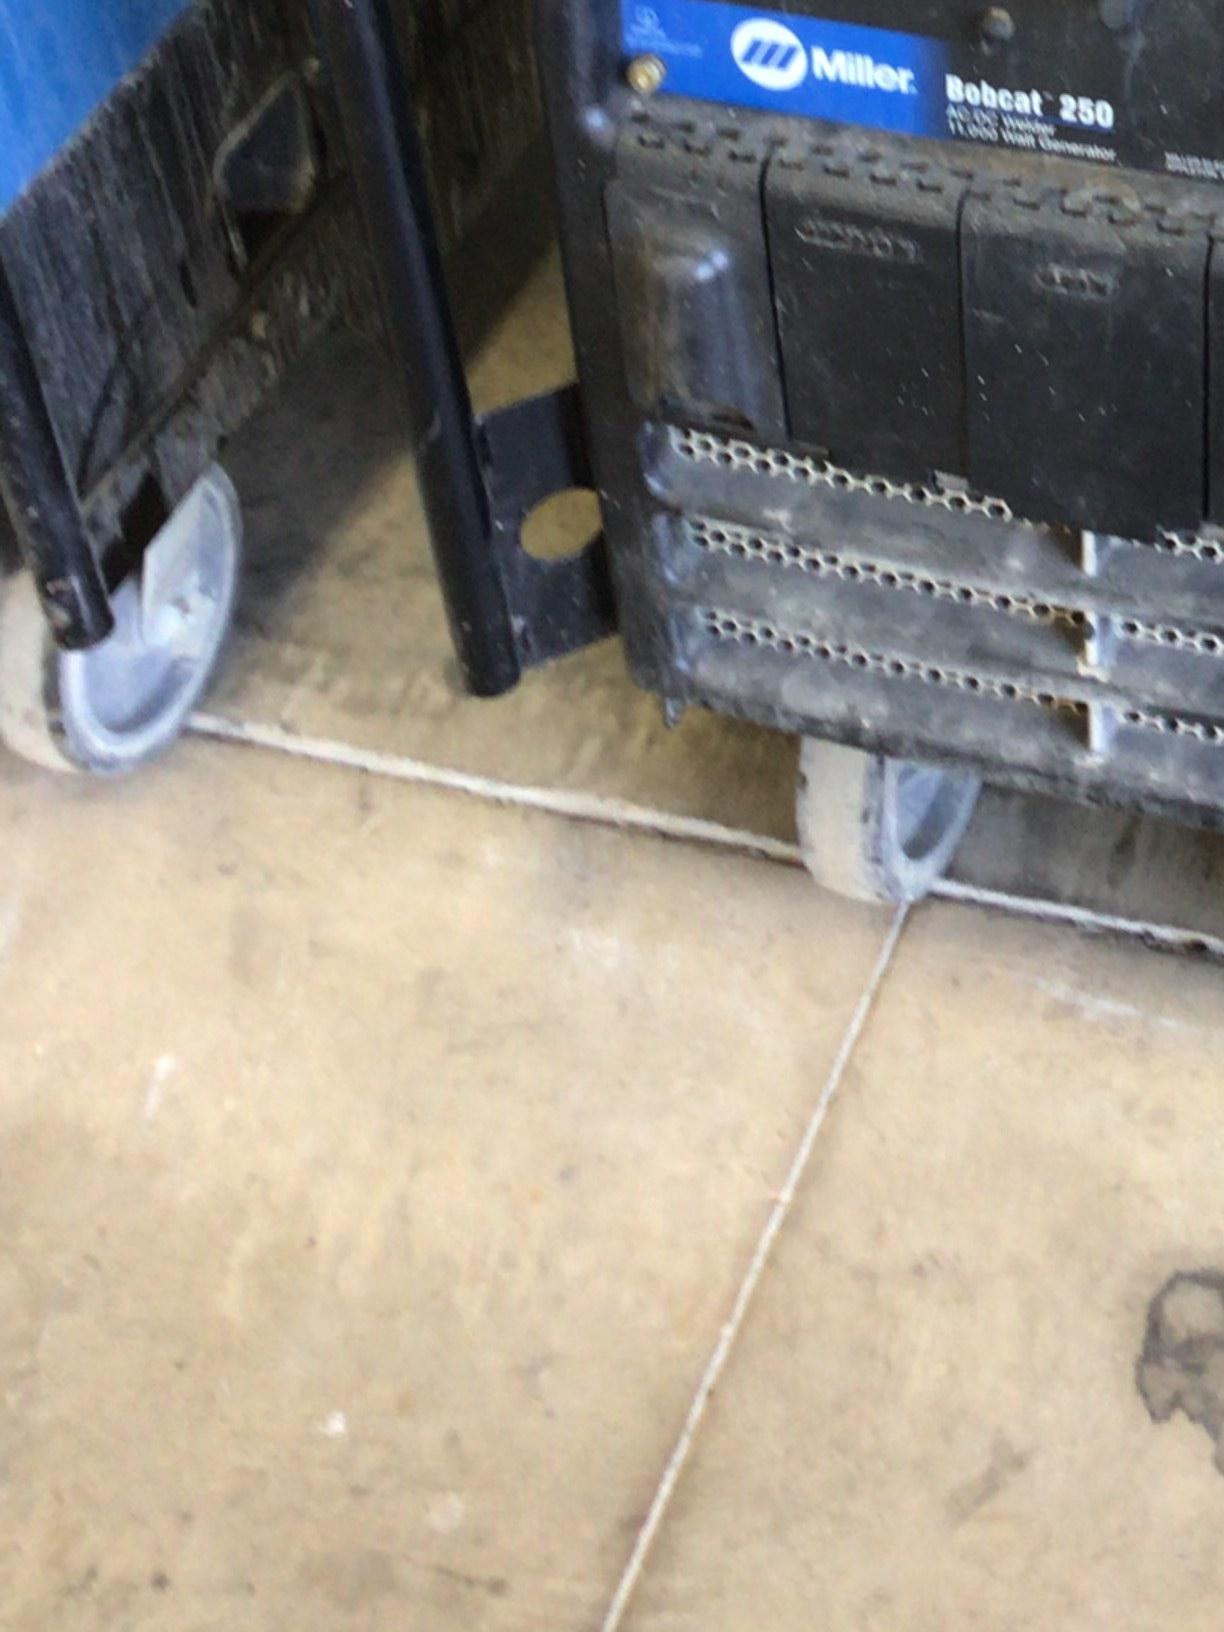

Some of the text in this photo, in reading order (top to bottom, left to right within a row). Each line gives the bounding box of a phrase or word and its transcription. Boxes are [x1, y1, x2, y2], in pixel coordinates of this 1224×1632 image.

[811, 45, 916, 95] Miller
[945, 73, 1115, 129] Bobcat 250
[1038, 134, 1117, 162] Generator
